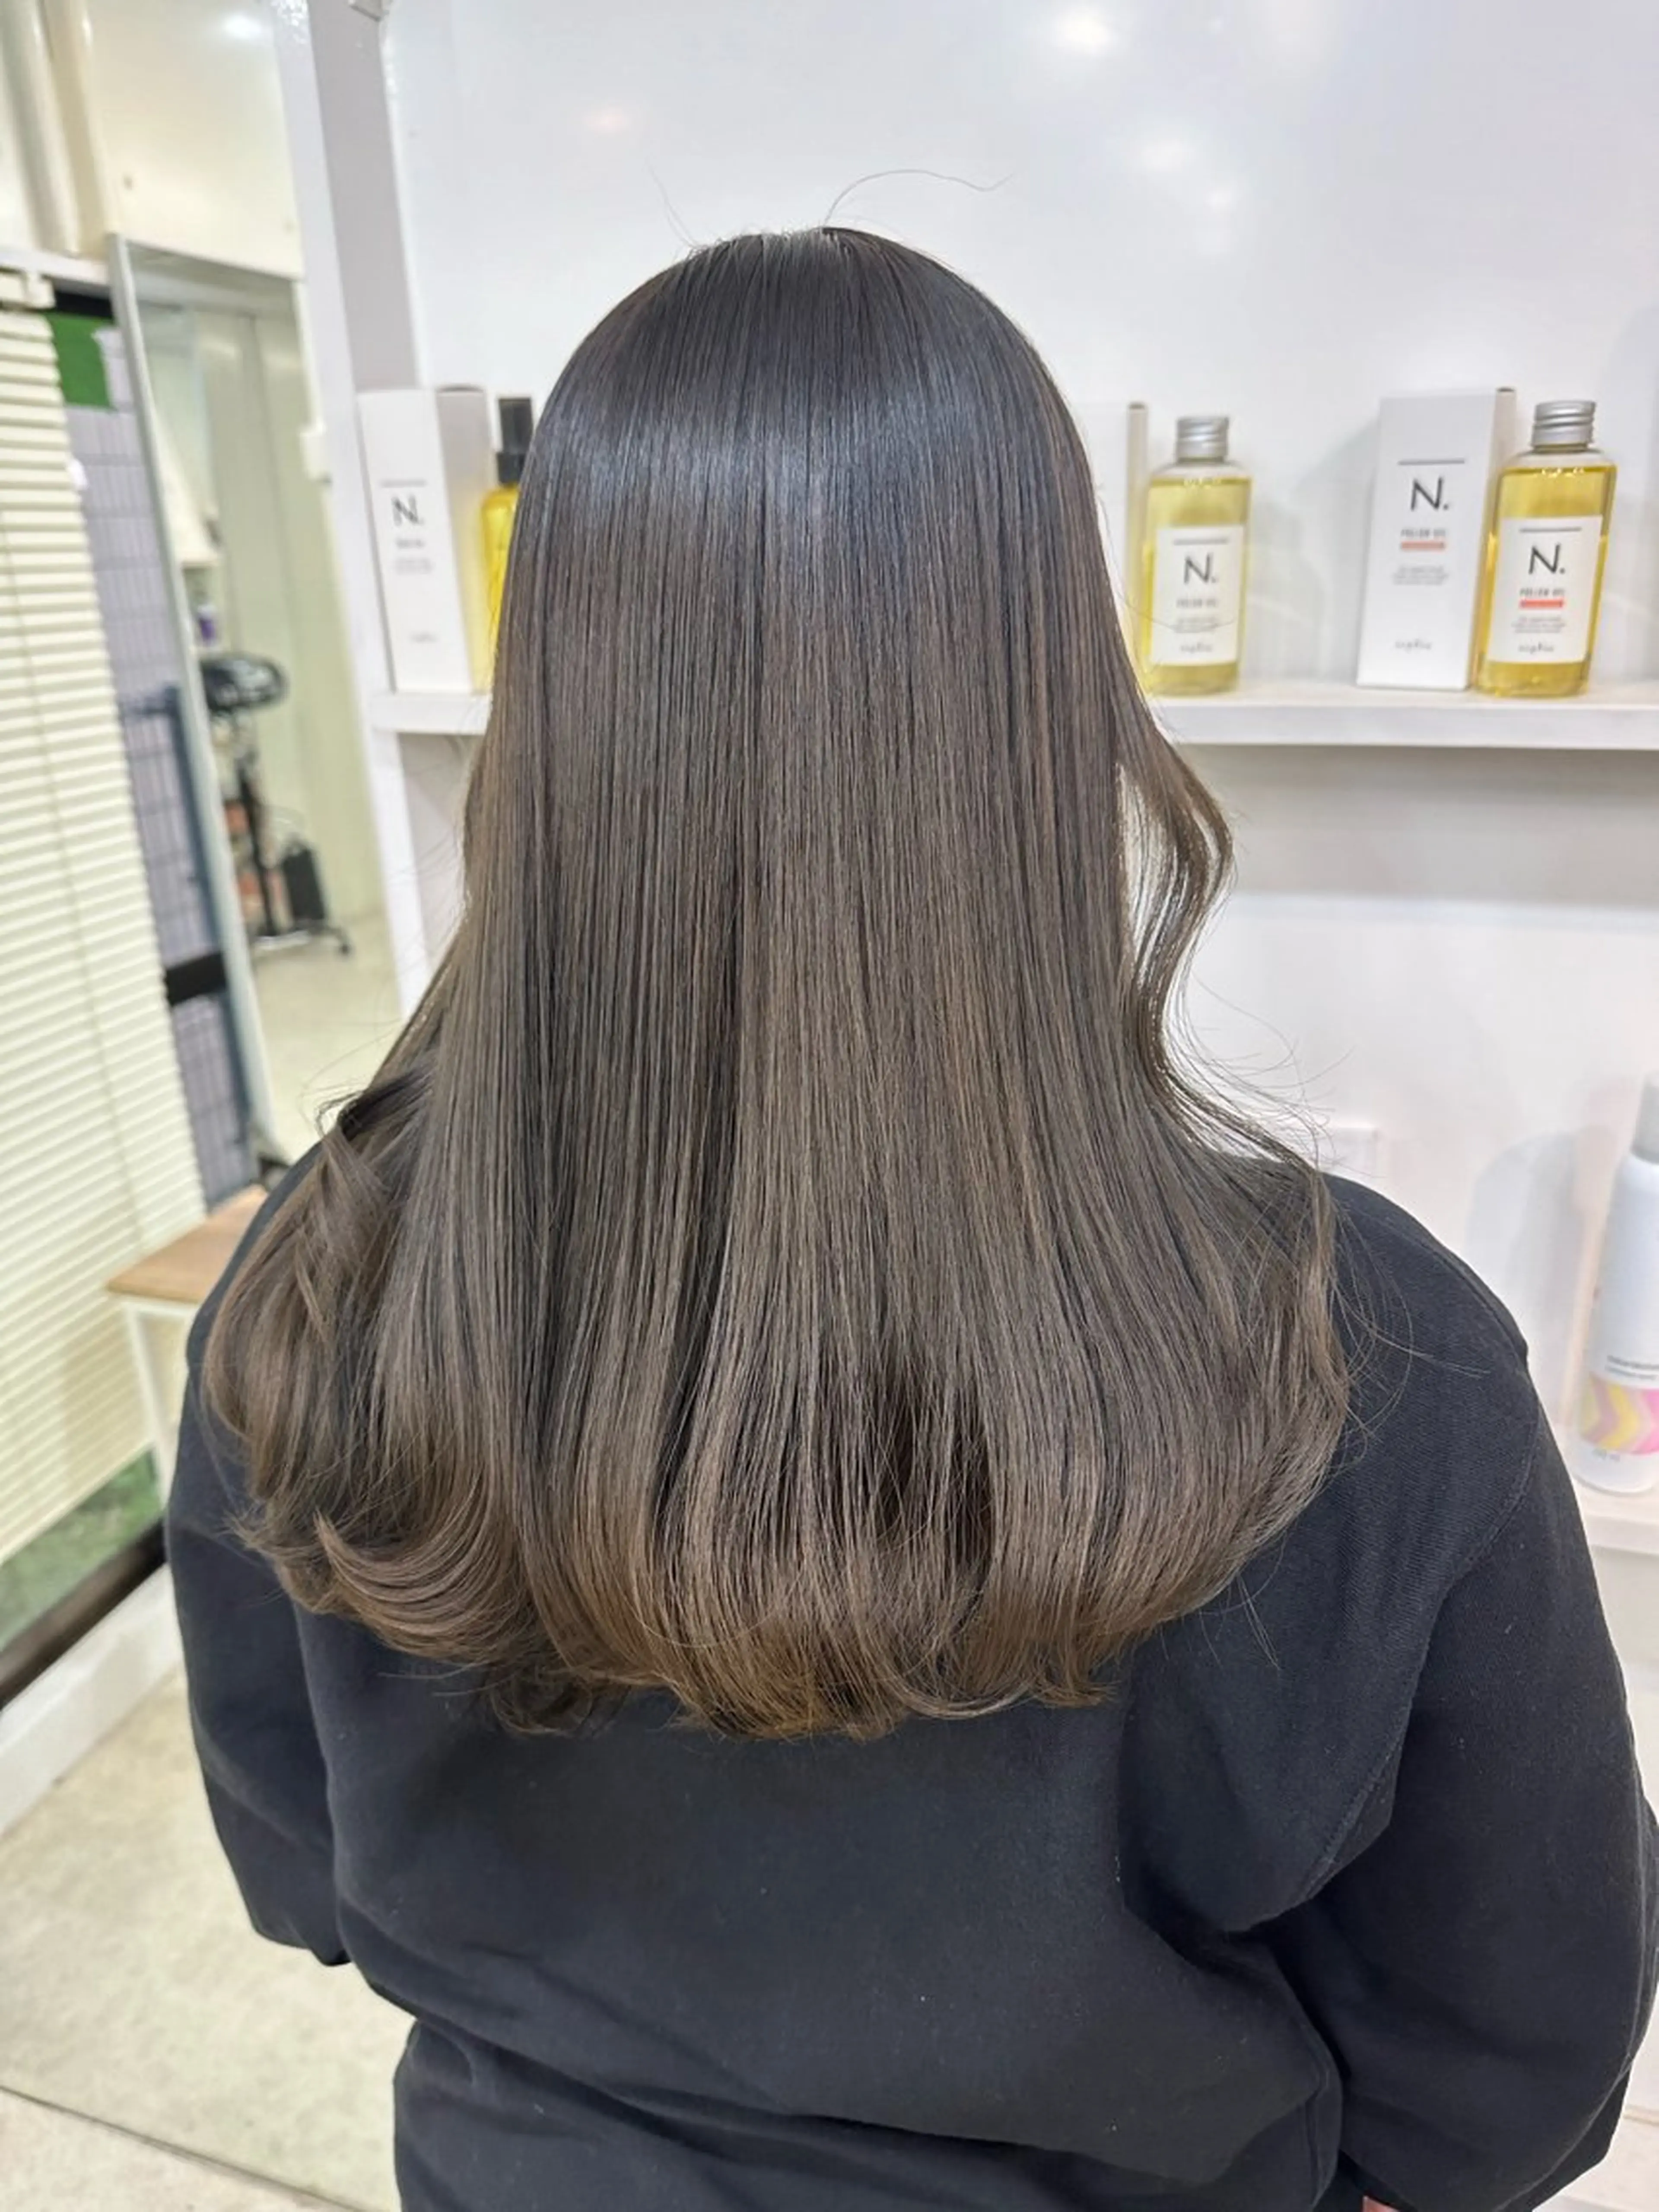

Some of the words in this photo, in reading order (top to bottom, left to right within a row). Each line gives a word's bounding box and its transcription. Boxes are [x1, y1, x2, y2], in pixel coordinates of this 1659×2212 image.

[1410, 476, 1449, 512] N.
[1183, 553, 1219, 585] N.
[1528, 543, 1565, 575] N.
